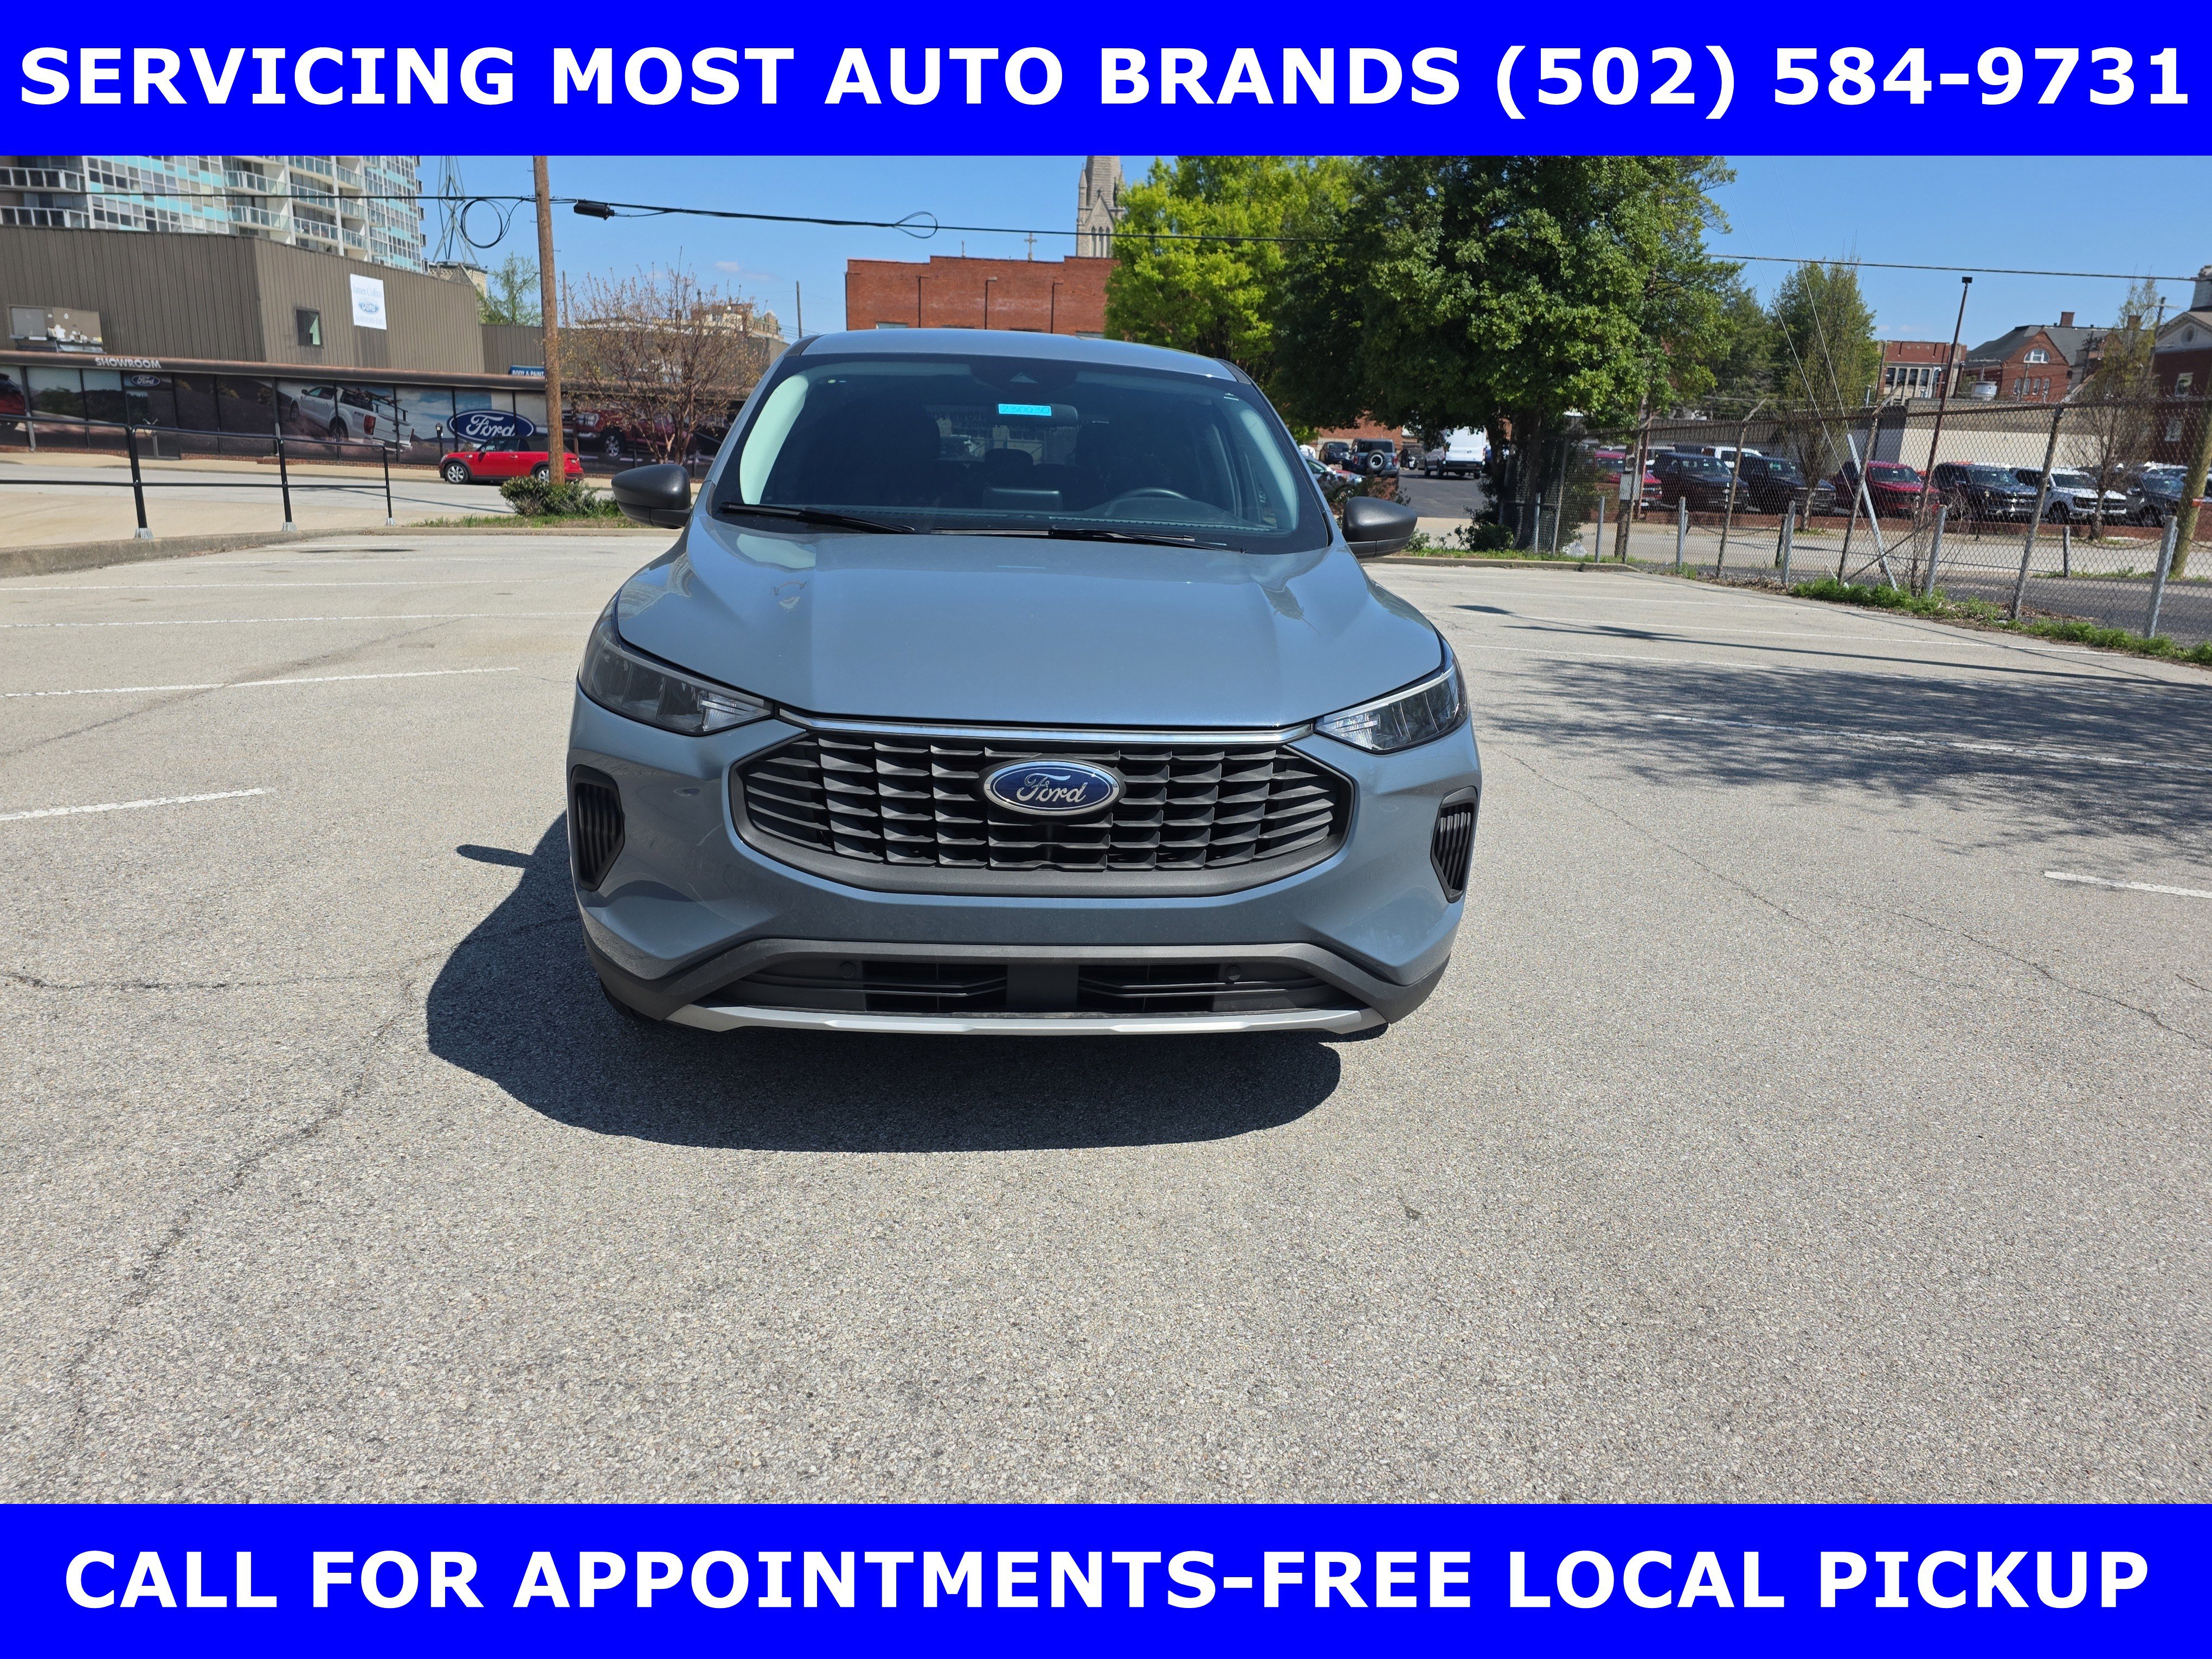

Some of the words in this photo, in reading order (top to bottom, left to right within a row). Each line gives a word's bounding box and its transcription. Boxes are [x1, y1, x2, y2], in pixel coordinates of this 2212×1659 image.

[95, 357, 162, 369] SHOWROOM
[466, 414, 515, 437] Ford
[1017, 773, 1088, 802] Ford
